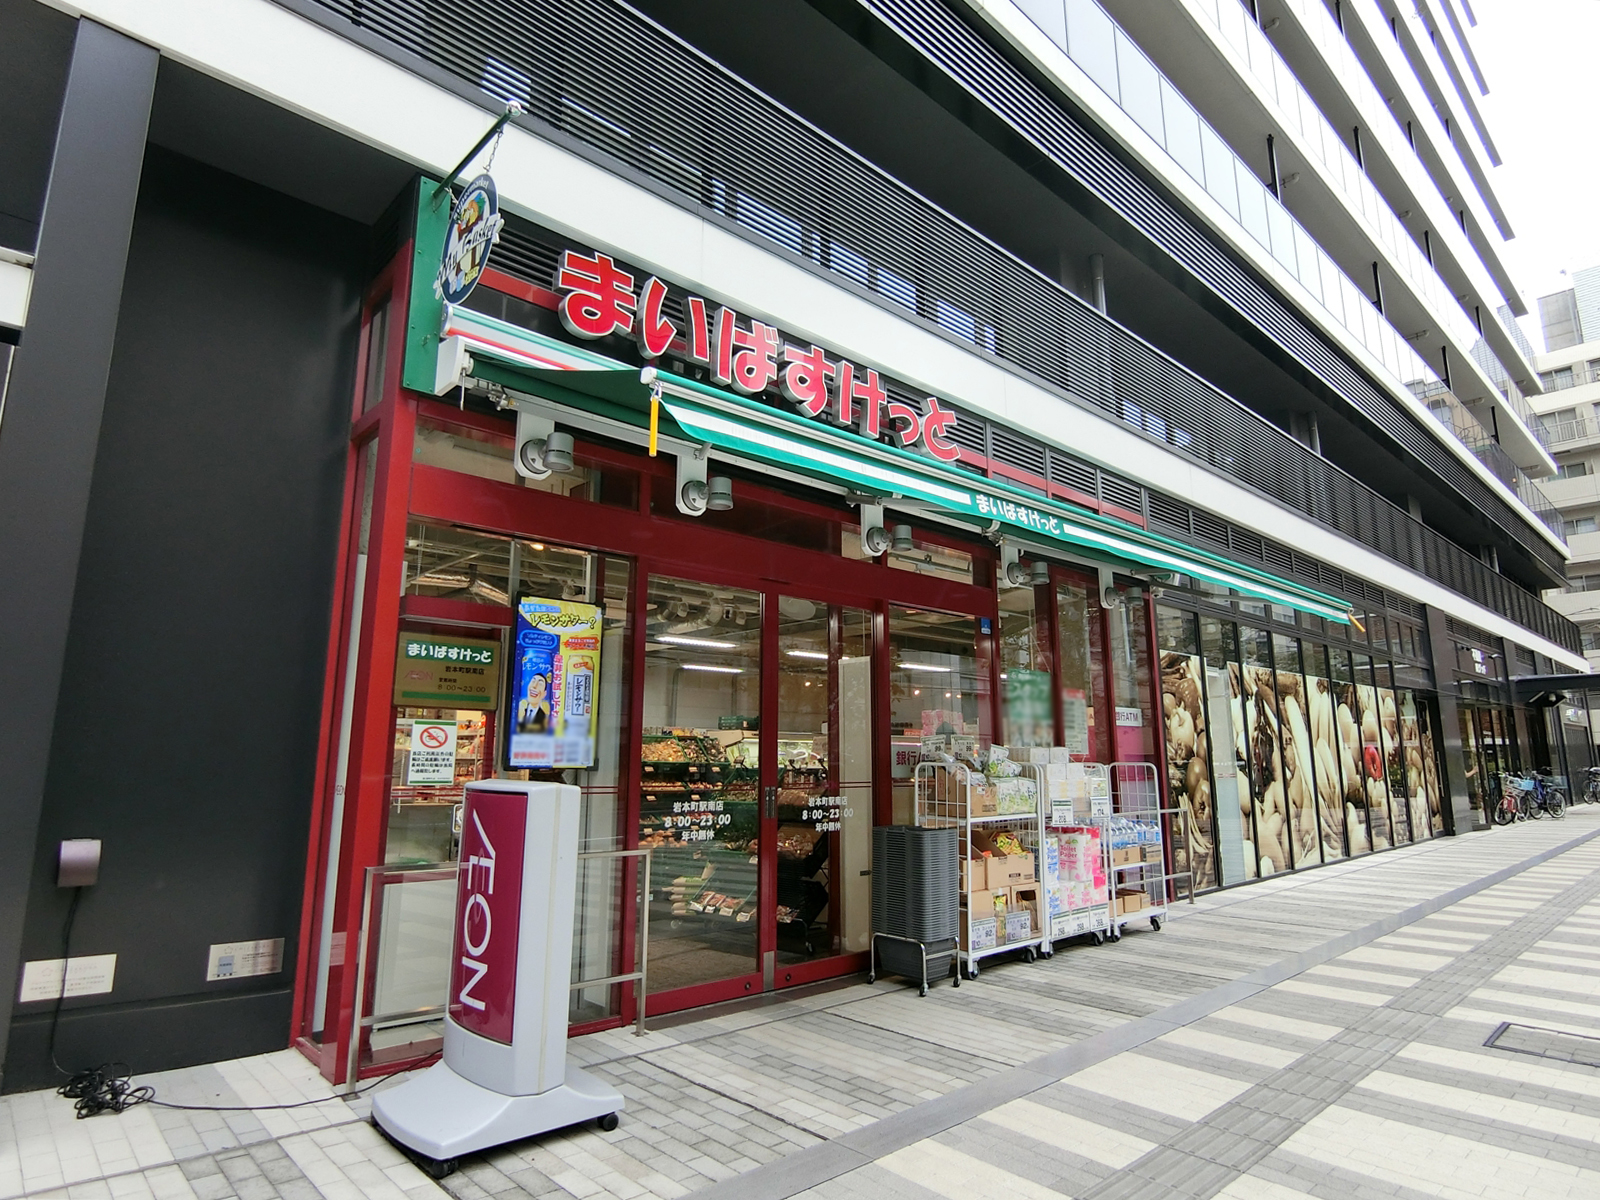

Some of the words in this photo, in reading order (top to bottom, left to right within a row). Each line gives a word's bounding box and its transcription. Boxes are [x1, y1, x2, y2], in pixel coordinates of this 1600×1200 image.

[553, 250, 961, 462] まいばすけっと
[975, 494, 1061, 535] まいばすけっと
[407, 643, 492, 663] まいばすけっと
[672, 801, 724, 813] 岩本町駅南店
[808, 795, 848, 807] 岩本町駅南店
[815, 822, 842, 832] 年中無休
[681, 829, 715, 842] 年中無休
[1060, 851, 1078, 859] Paper
[459, 808, 497, 1012] AEON
